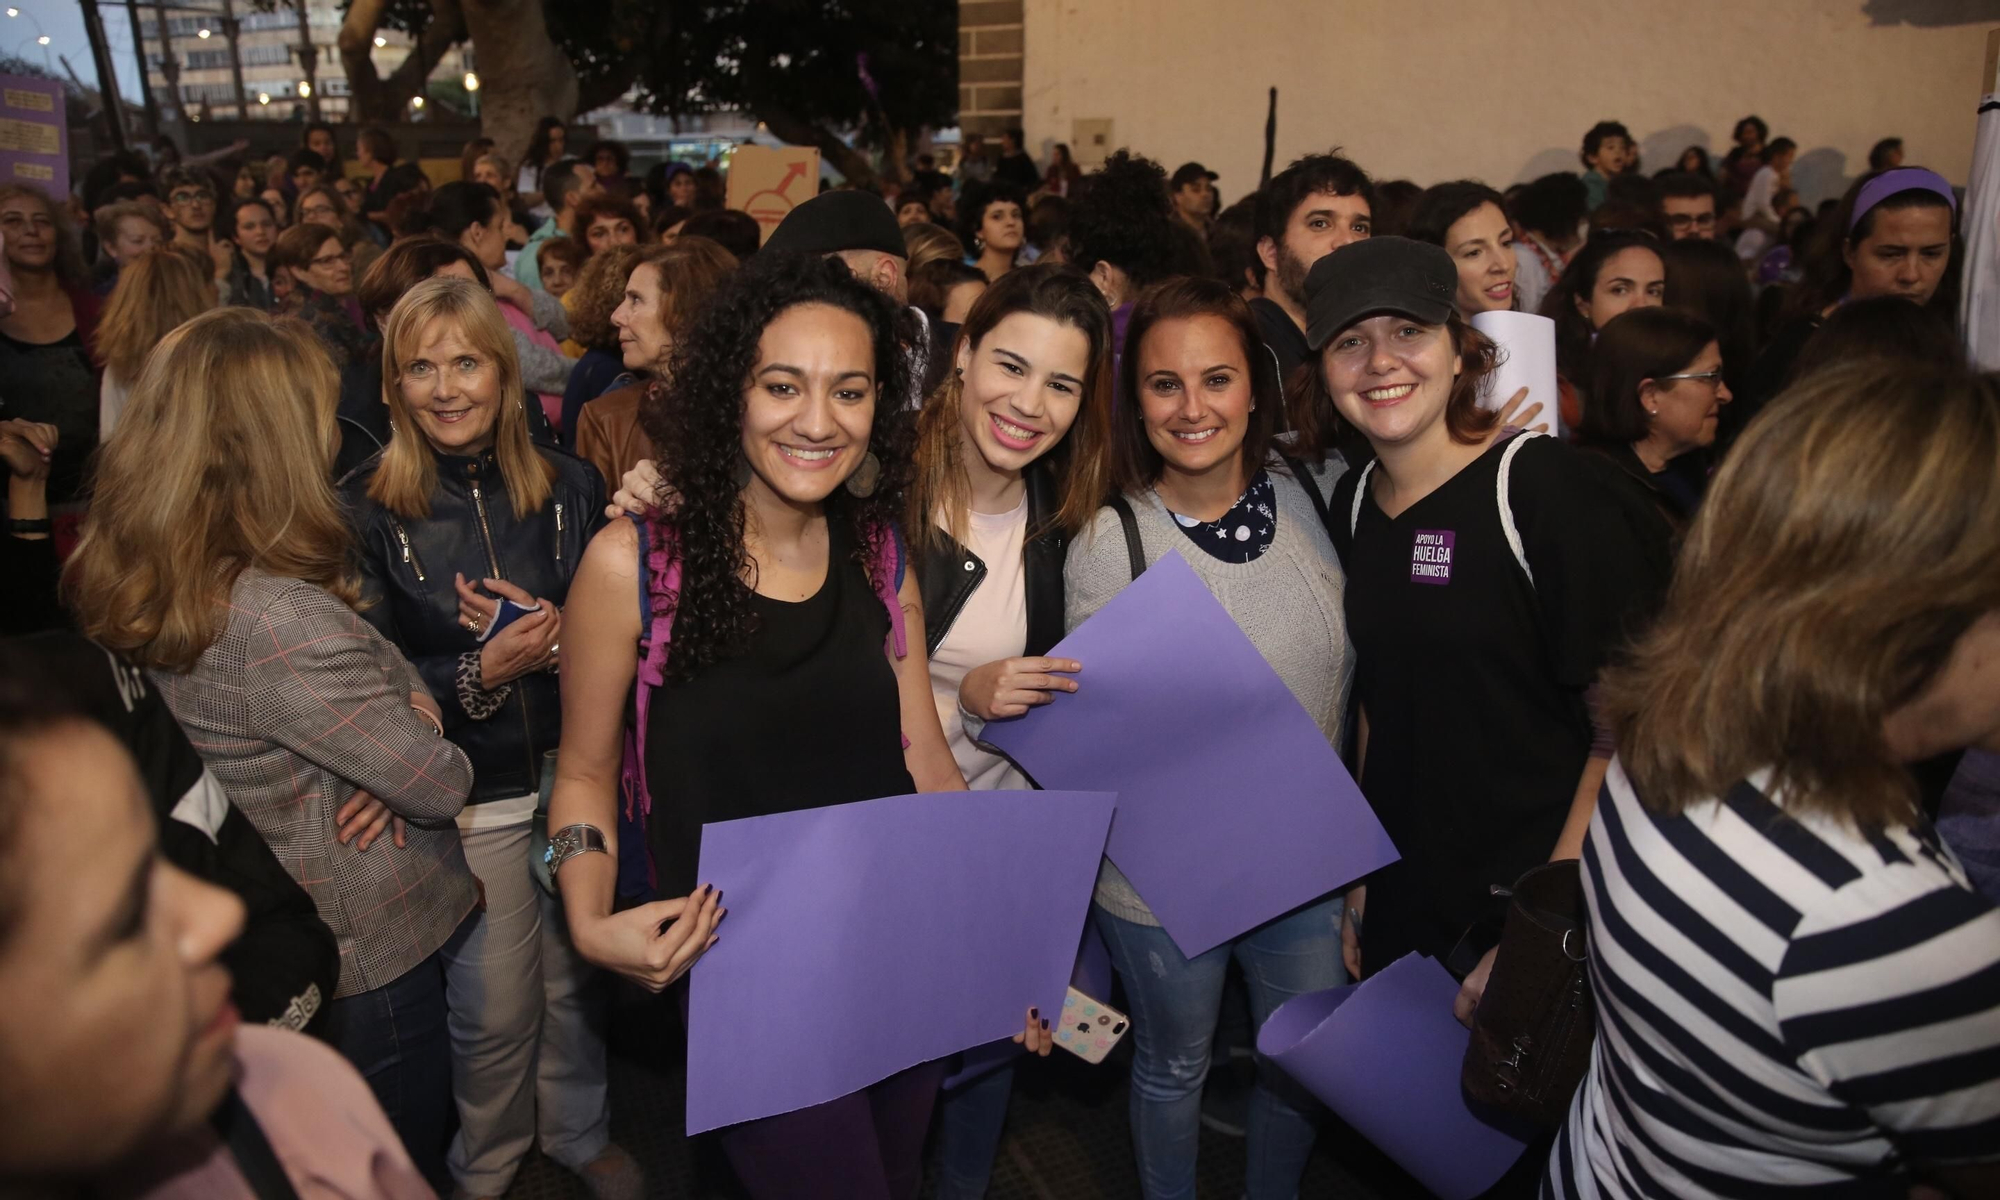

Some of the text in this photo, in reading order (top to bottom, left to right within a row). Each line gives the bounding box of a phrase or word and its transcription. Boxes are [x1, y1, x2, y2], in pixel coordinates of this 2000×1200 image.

[1415, 534, 1443, 545] APOYO LA
[1413, 546, 1450, 563] HUELGA
[1412, 563, 1449, 578] FEMINISTA
